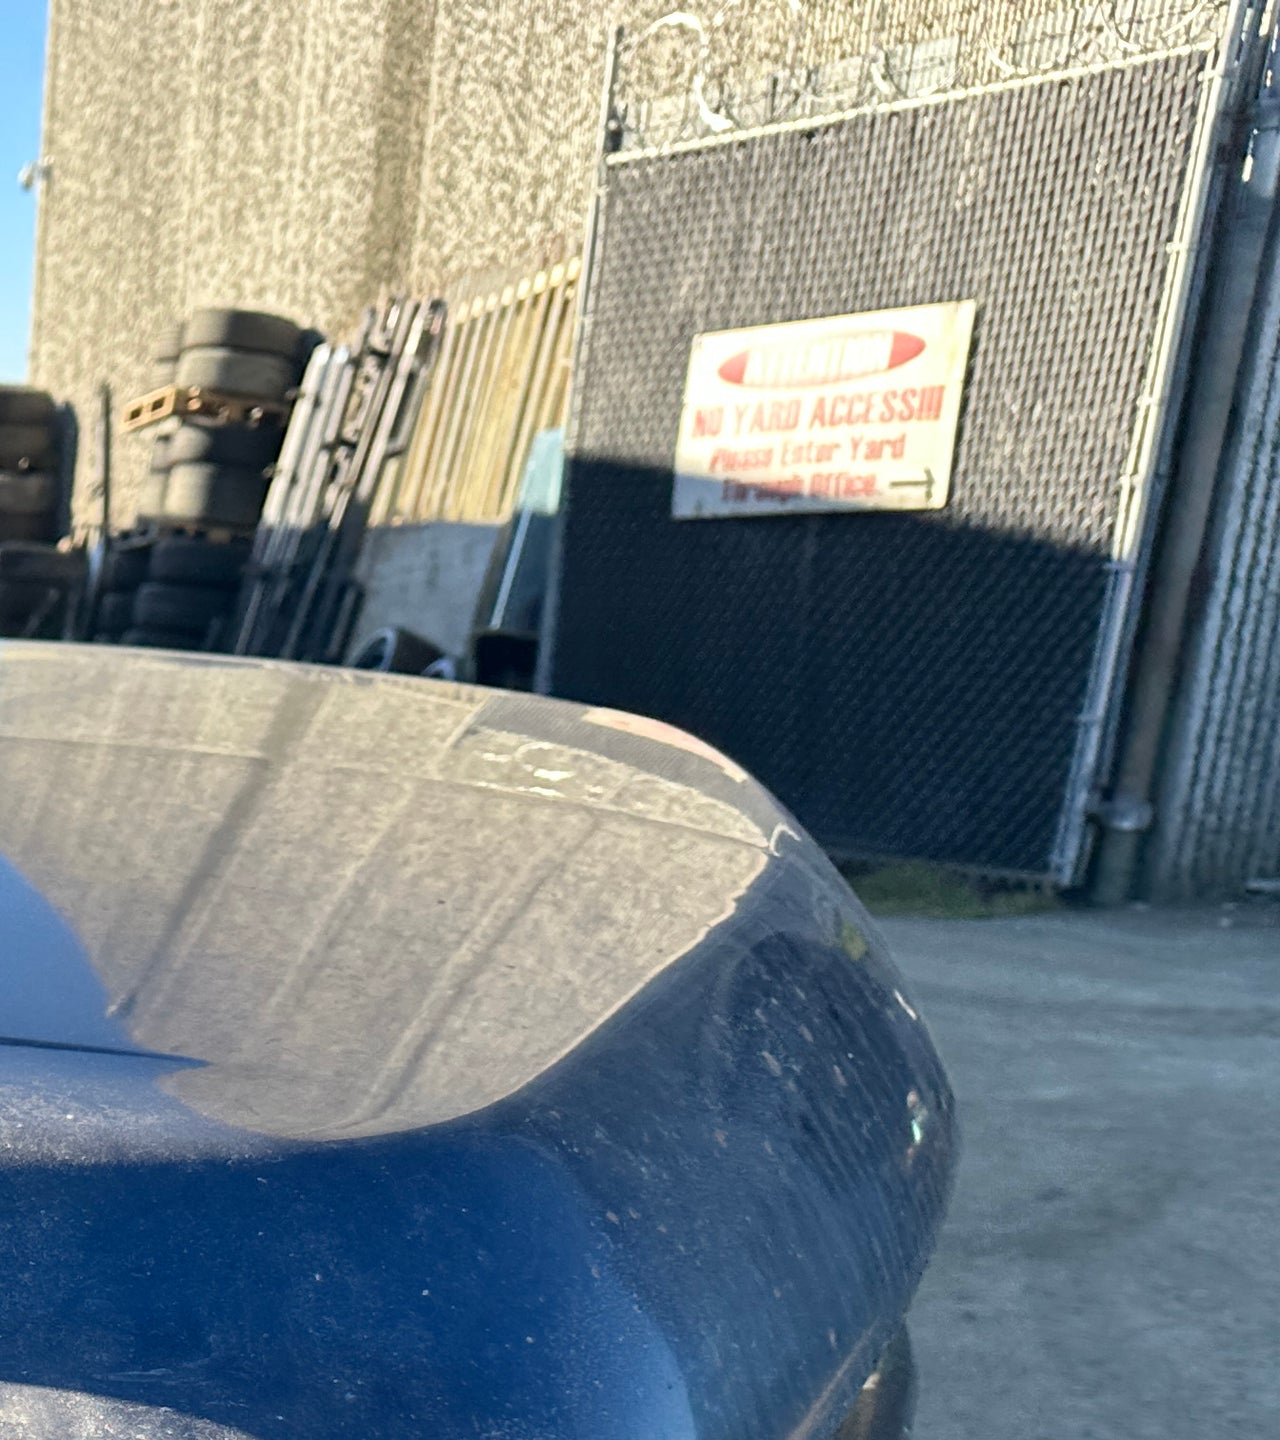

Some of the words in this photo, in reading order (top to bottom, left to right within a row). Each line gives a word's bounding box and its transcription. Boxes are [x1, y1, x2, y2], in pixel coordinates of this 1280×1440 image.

[691, 406, 724, 438] NO
[734, 398, 802, 435] YARD
[851, 433, 907, 461] Yard
